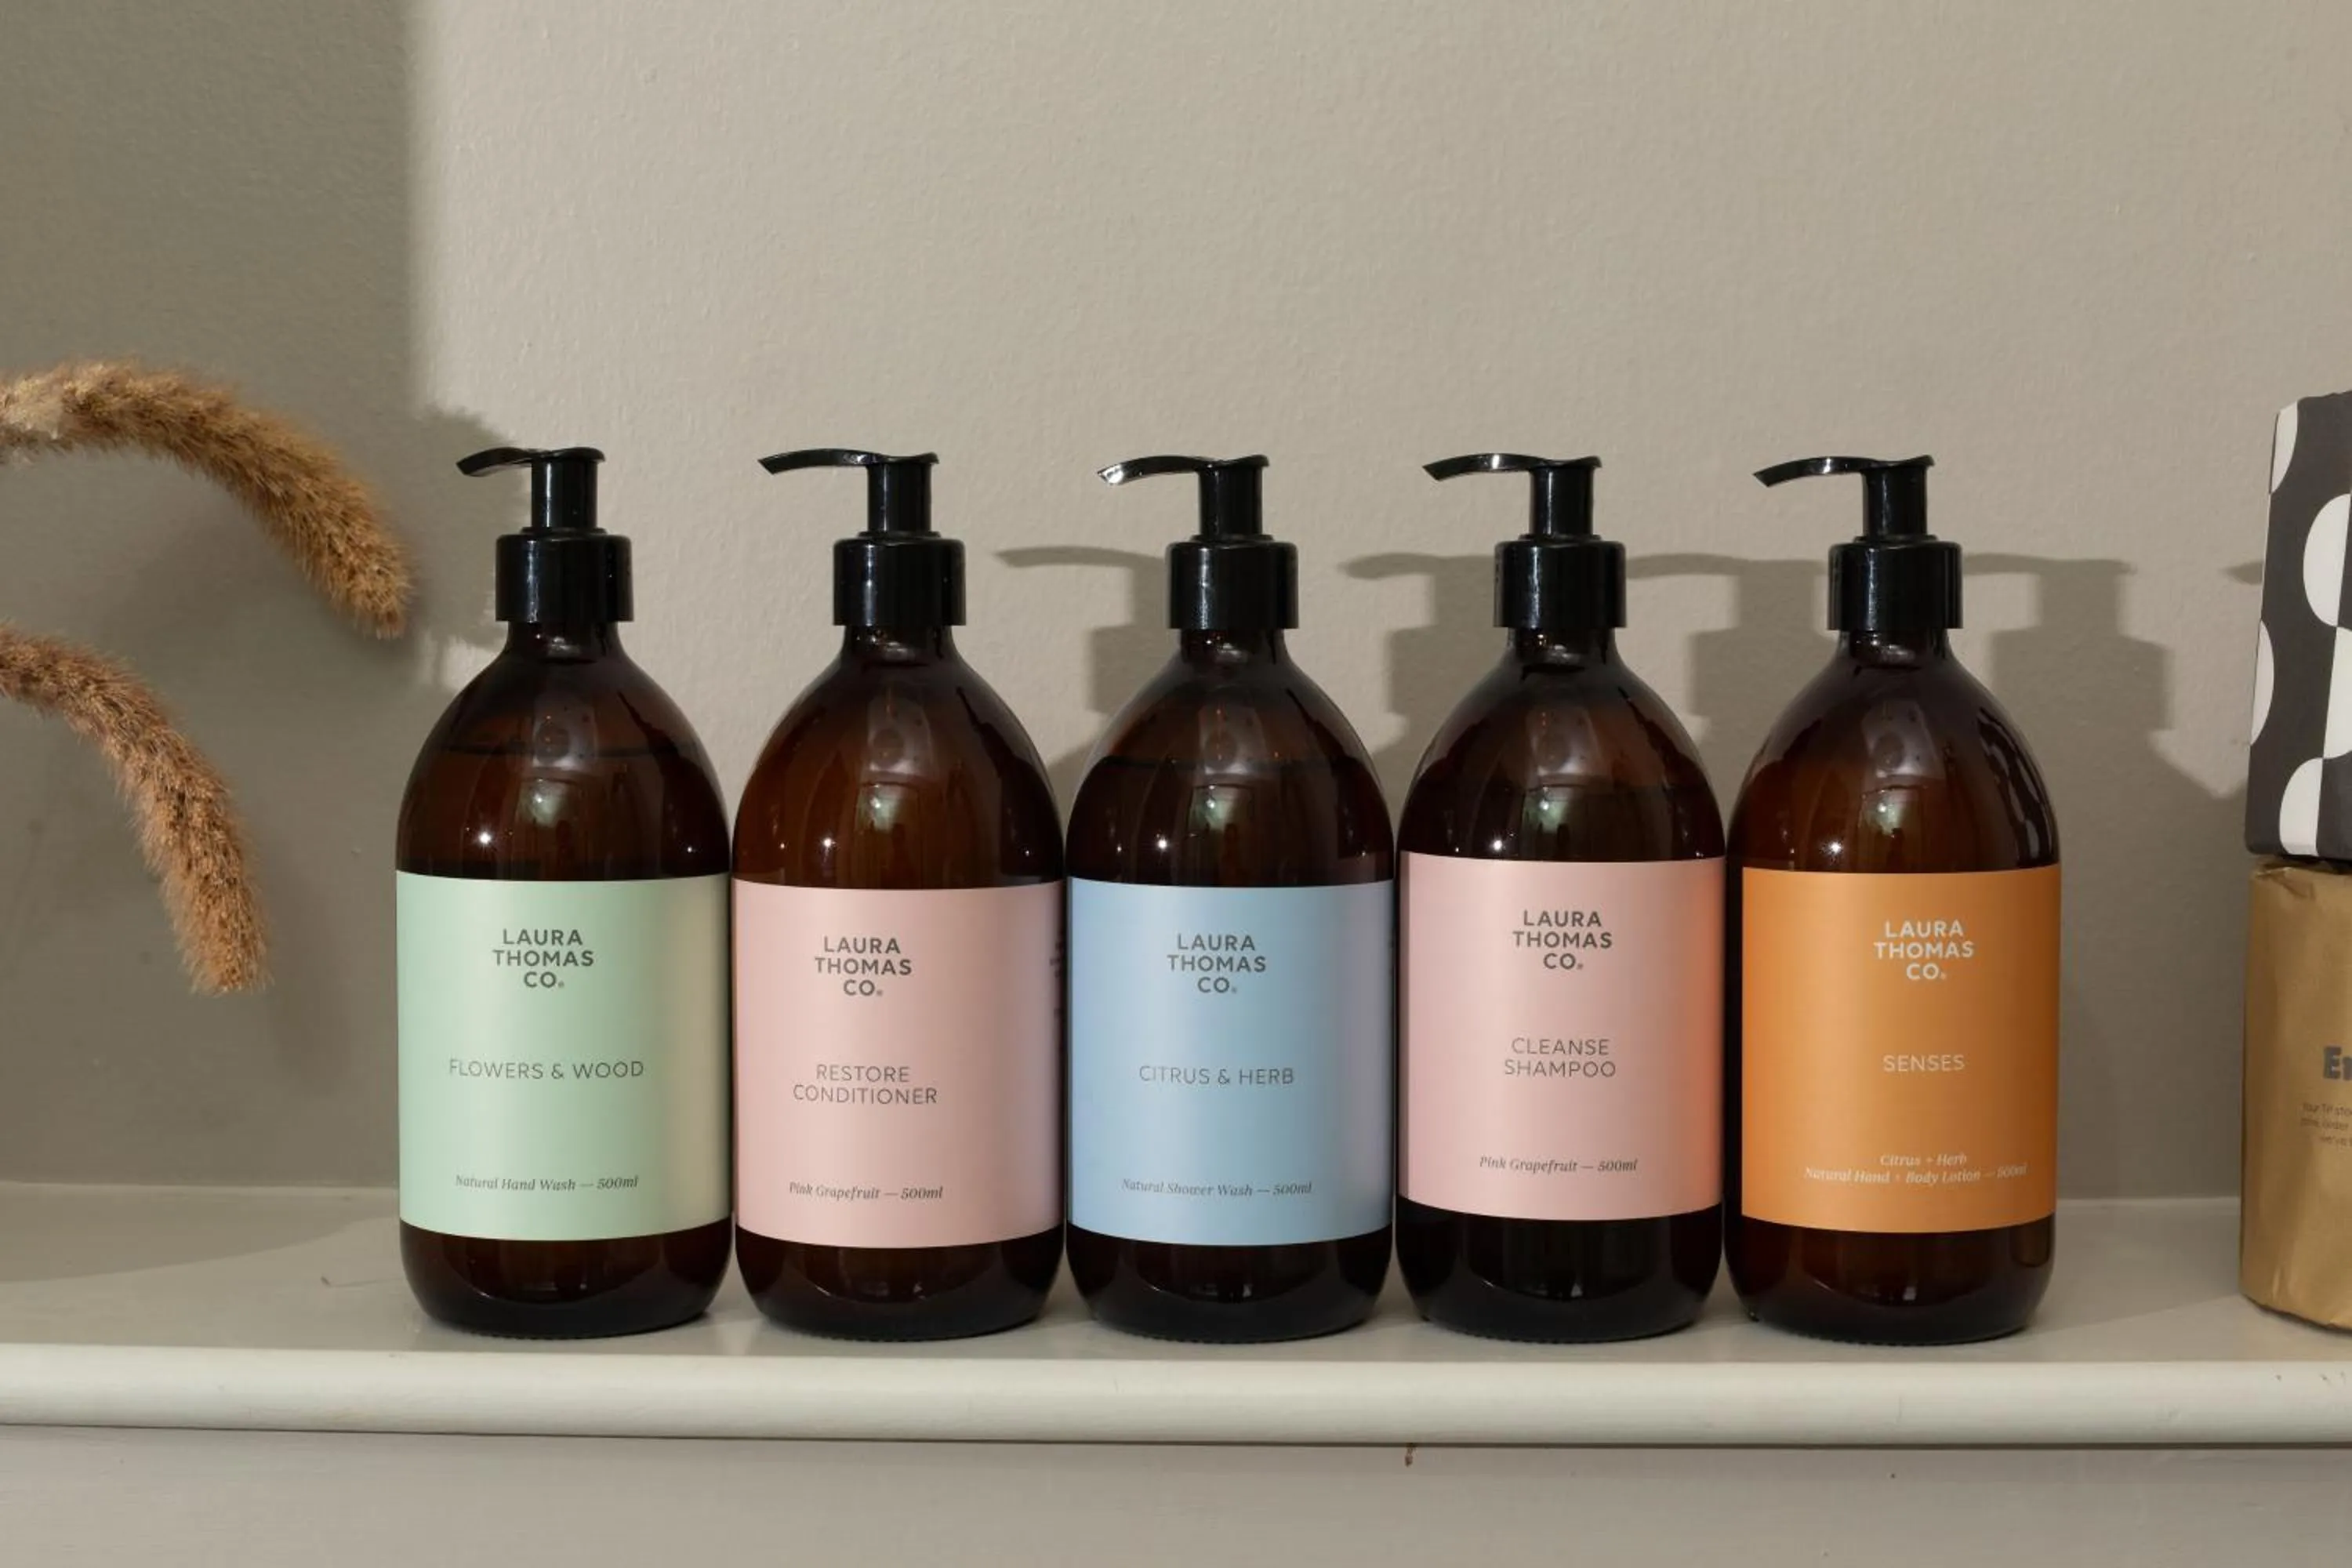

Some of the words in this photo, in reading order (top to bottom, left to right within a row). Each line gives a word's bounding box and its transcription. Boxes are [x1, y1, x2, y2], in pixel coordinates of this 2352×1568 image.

[1523, 909, 1601, 927] LAURA
[503, 928, 583, 946] LAURA
[1886, 920, 1963, 938] LAURA
[824, 936, 901, 954] LAURA
[1177, 934, 1255, 952] LAURA
[1512, 931, 1613, 949] THOMAS
[493, 950, 594, 967] THOMAS
[1874, 941, 1974, 959] THOMAS
[815, 957, 912, 975] THOMAS
[1167, 955, 1266, 973] THOMAS
[1512, 1037, 1609, 1056] CLEANSE
[449, 1058, 544, 1080] FLOWERS
[551, 1063, 564, 1080] &
[572, 1061, 644, 1079] WOOD
[1504, 1059, 1616, 1078] SHAMPOO
[1883, 1055, 1965, 1073] SENSES
[816, 1064, 910, 1083] RESTORE
[1139, 1065, 1210, 1084] CITRUS
[1217, 1069, 1230, 1085] &
[1240, 1069, 1294, 1084] HERB
[793, 1084, 938, 1105] CONDITIONER
[1479, 1156, 1506, 1170] Pink
[1509, 1157, 1578, 1174] Grapefruit
[1597, 1159, 1638, 1172] 500ml
[456, 1174, 498, 1189] Natural
[501, 1178, 535, 1191] Hand
[540, 1178, 575, 1191] Wash
[597, 1176, 638, 1189] 500ml
[789, 1182, 812, 1196] Pink
[816, 1184, 881, 1201] Grapefruit
[901, 1186, 943, 1200] 500ml
[1122, 1179, 1164, 1192] Natural
[1167, 1182, 1214, 1196] Shower
[1218, 1184, 1253, 1196] Wash
[1272, 1182, 1312, 1196] 500ml
